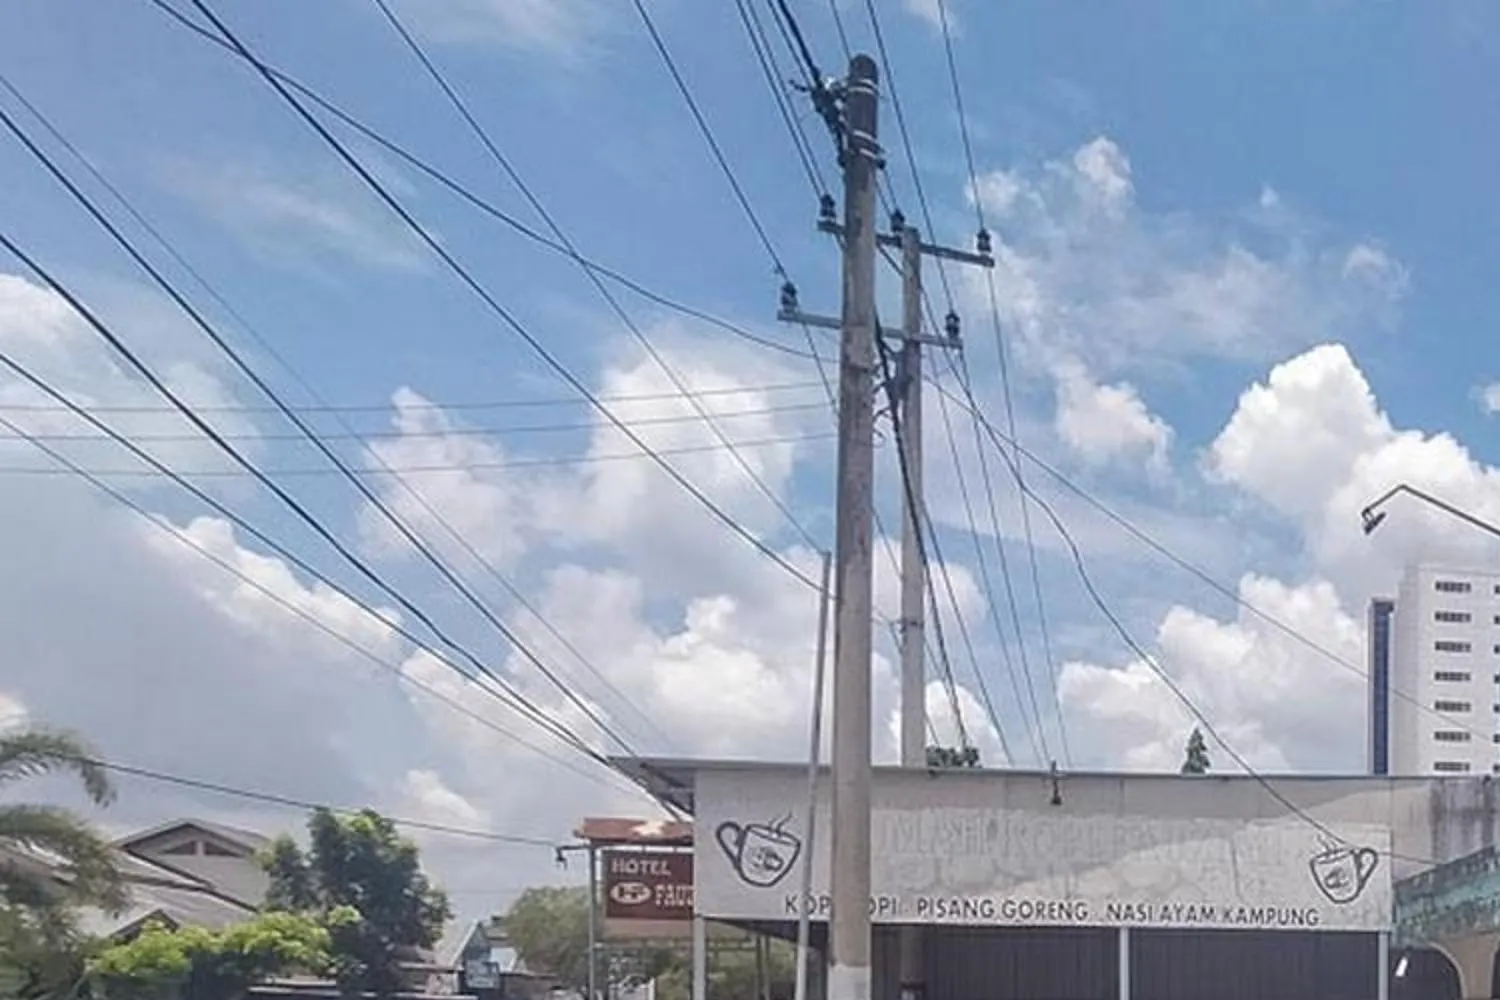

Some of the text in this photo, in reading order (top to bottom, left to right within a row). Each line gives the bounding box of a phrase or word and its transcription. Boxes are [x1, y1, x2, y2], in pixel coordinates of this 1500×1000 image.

[611, 859, 672, 876] HOTEL
[784, 895, 1320, 926] KOP OPI PISANG GORENG NASI AYAM KAMPUNG
